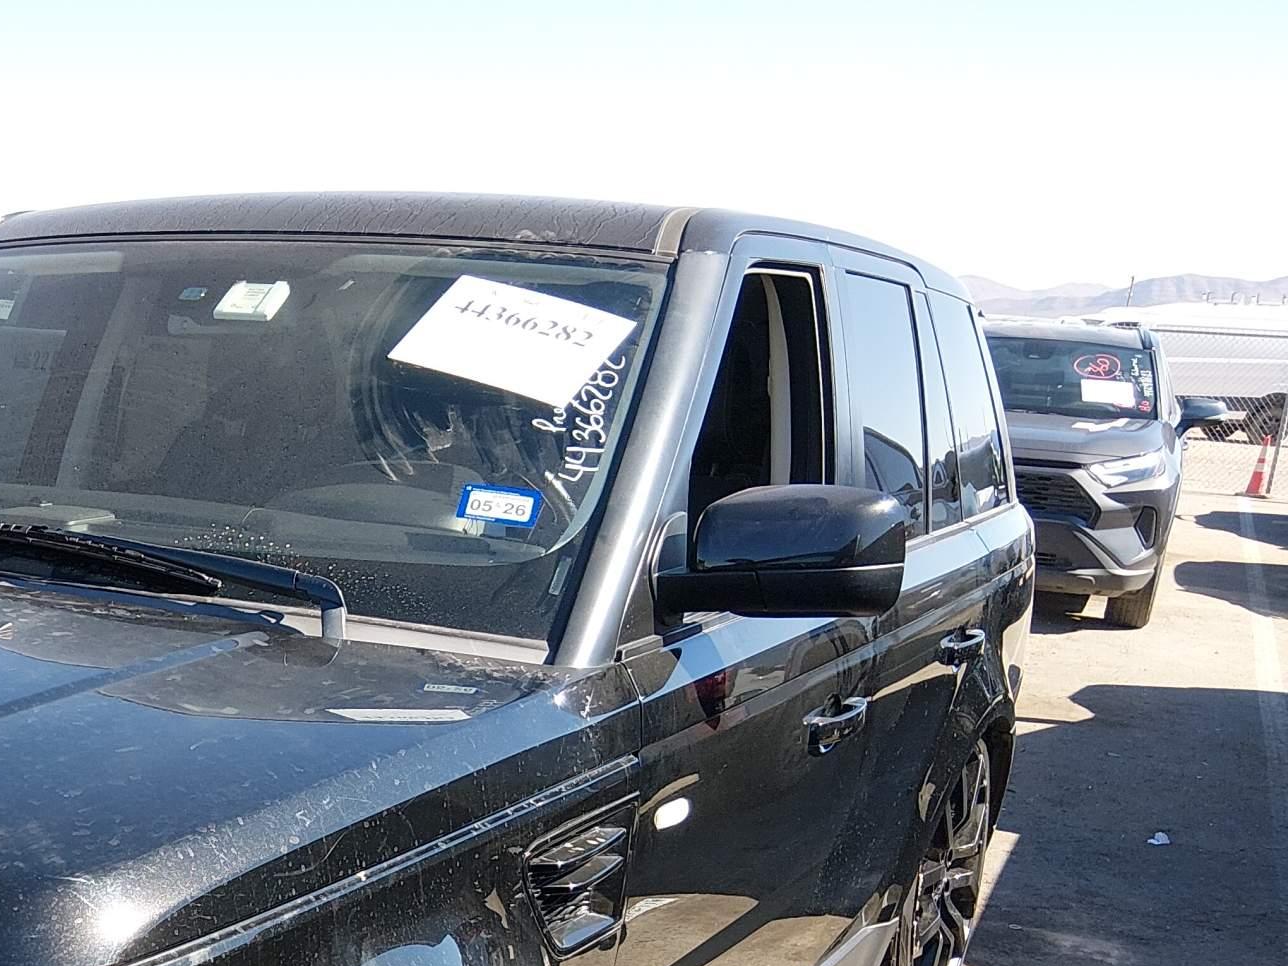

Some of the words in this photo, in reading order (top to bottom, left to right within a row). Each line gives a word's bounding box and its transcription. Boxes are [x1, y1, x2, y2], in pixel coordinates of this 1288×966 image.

[455, 300, 594, 347] 44366282
[470, 499, 493, 512] 05
[503, 502, 527, 516] 26
